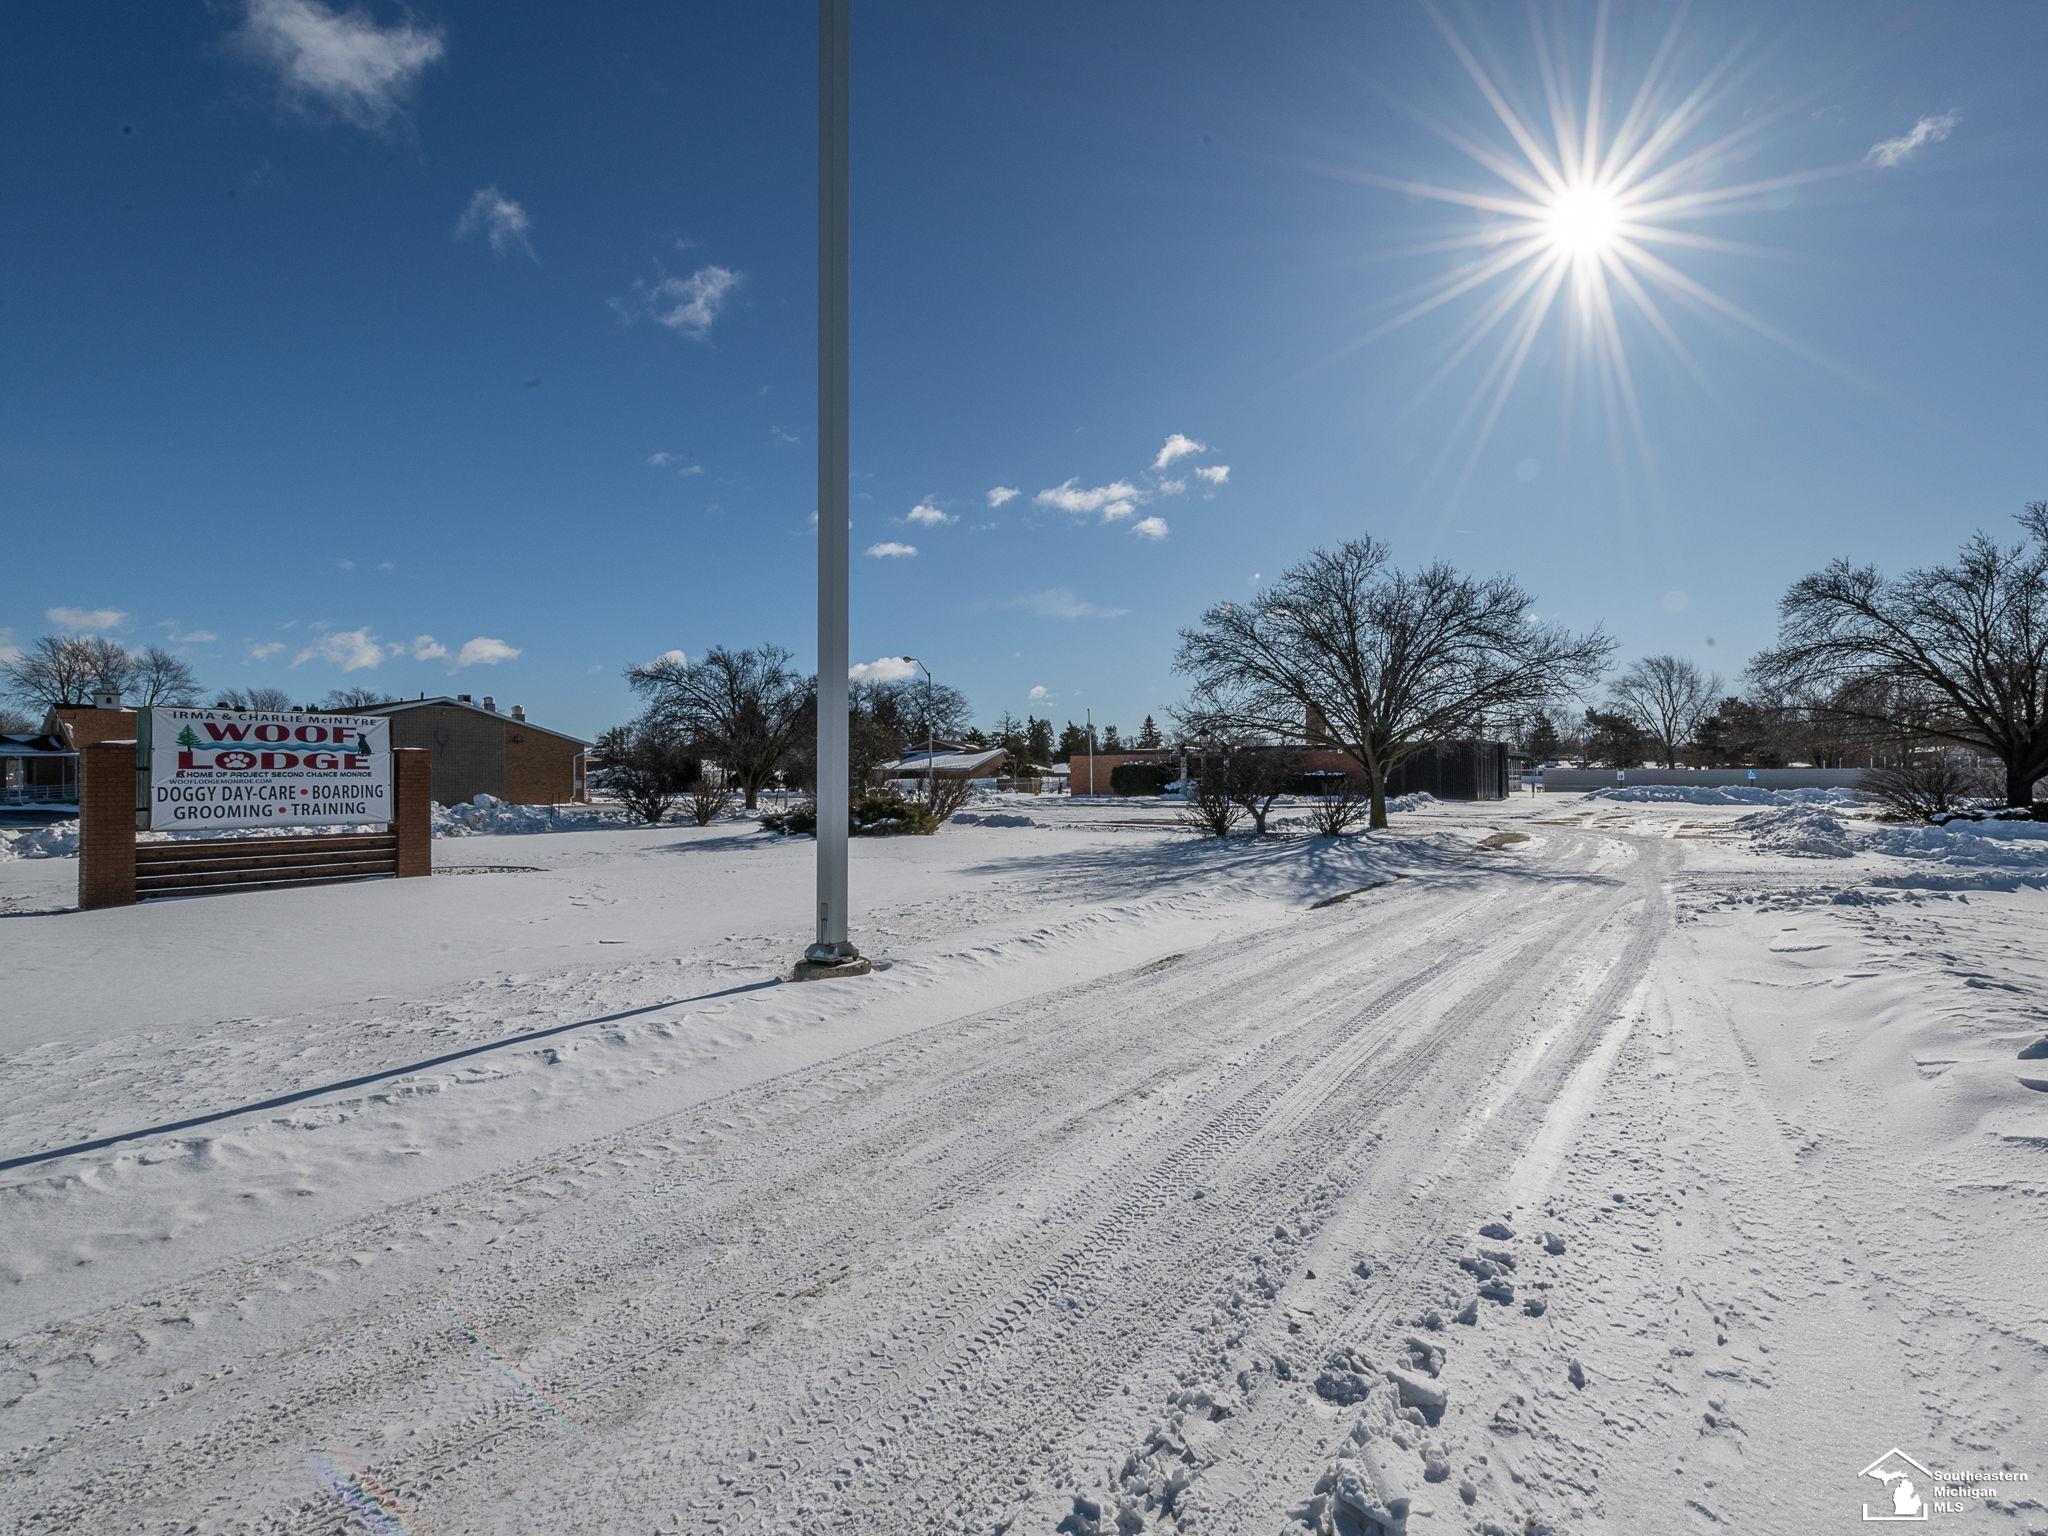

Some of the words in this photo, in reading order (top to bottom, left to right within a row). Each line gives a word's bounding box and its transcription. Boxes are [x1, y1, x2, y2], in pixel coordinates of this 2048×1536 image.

[173, 711, 214, 719] IRMA
[239, 713, 302, 722] CHARLIE
[203, 723, 357, 743] WOOF
[178, 751, 370, 770] LODGE
[157, 786, 216, 802] DOGGY
[222, 785, 296, 801] DAY-CARE
[313, 784, 384, 799] BOARDING
[174, 804, 273, 819] GROOMING
[291, 802, 366, 816] TRAINING
